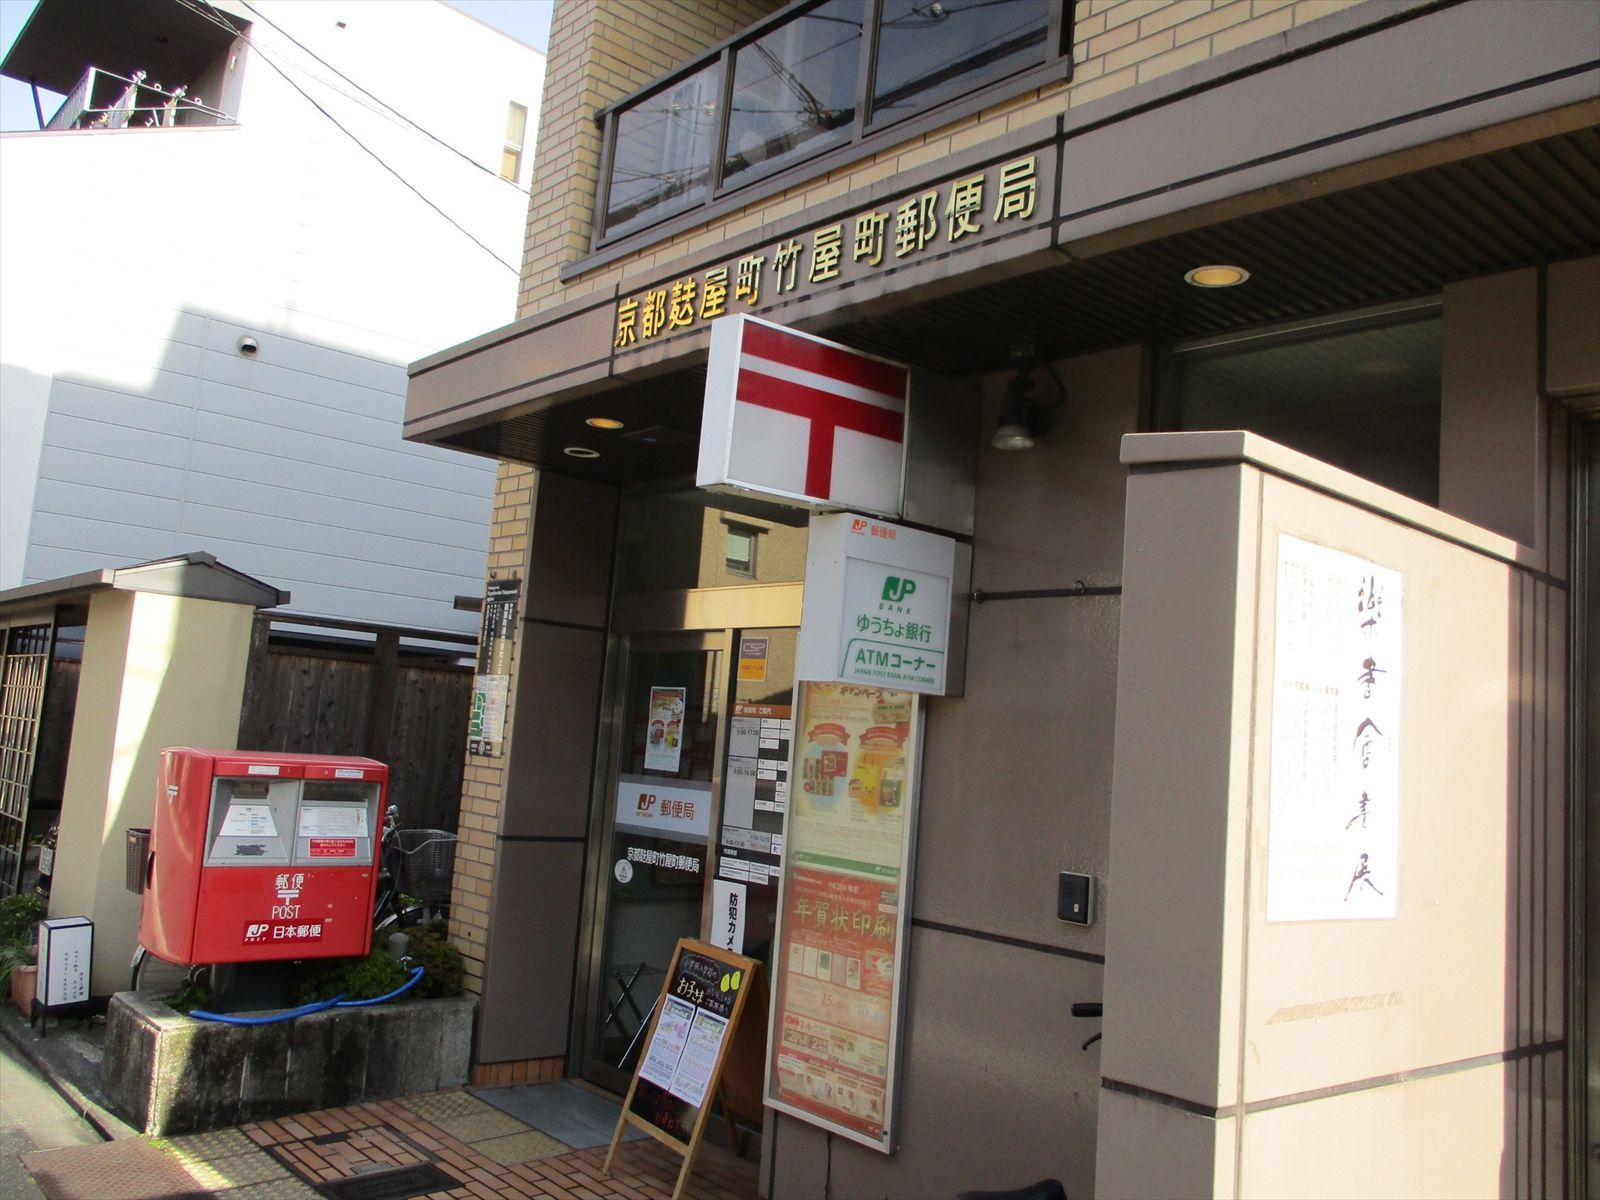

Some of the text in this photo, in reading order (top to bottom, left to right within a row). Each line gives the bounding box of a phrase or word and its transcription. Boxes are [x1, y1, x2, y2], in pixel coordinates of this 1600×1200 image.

[870, 525, 897, 541] 郵便局
[881, 575, 916, 603] JP
[878, 602, 912, 615] BANK
[856, 614, 933, 643] ゆうちょ銀行
[855, 648, 936, 672] ATMコーナー
[854, 668, 935, 684] JAPAN POST BANK ATM CORNER
[637, 793, 695, 821] JP 郵便局
[275, 873, 305, 890] 郵便
[271, 905, 302, 919] POST
[727, 892, 740, 953] 防犯カメ
[793, 896, 896, 941] 年賀状印刷
[245, 923, 322, 939] JP 日本郵便
[677, 977, 705, 1004] お子さま
